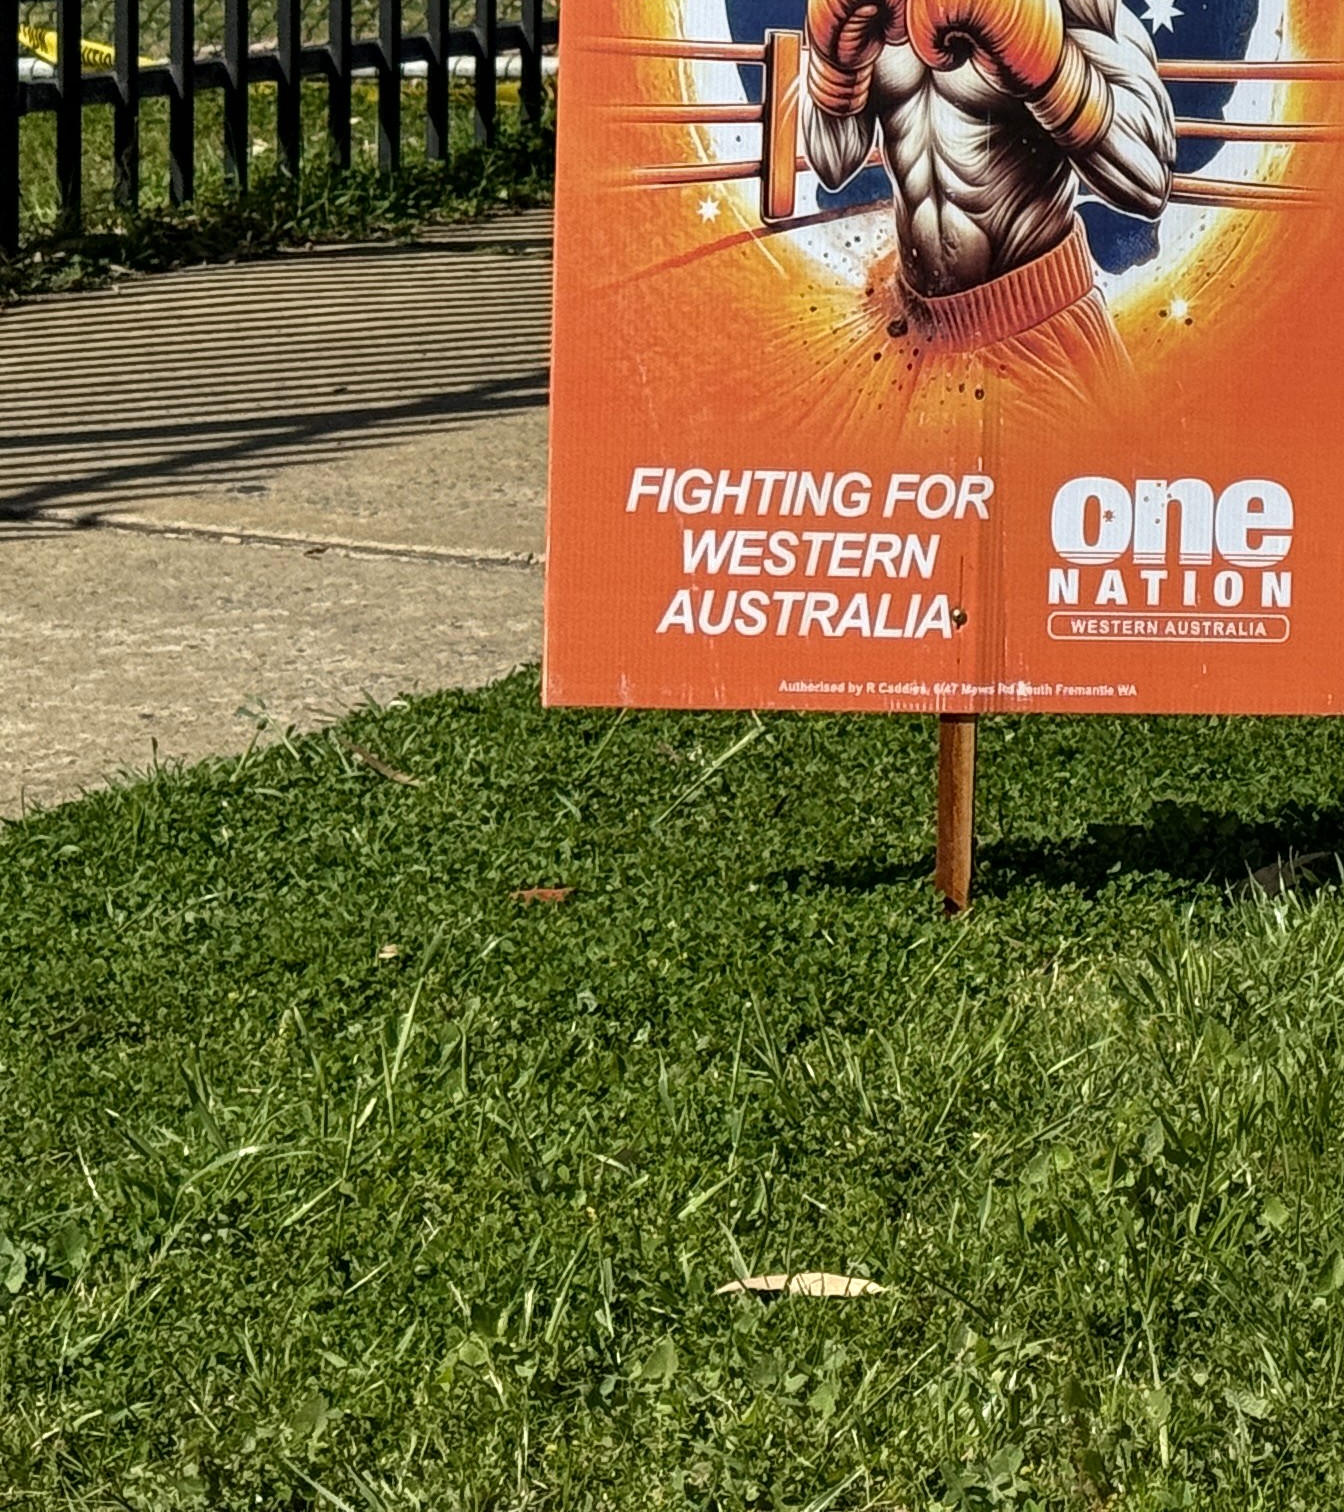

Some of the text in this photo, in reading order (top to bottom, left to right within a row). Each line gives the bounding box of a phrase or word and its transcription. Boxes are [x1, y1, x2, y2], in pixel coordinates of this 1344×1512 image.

[625, 467, 995, 520] FIGHTING FOR
[1051, 476, 1294, 568] one
[682, 528, 940, 580] WESTERN
[1047, 567, 1292, 608] NATION
[655, 589, 953, 640] AUSTRALIA
[1070, 618, 1267, 638] WESTERN AUSTRALIA
[778, 680, 845, 694] Authorised
[848, 682, 863, 697] by
[867, 683, 875, 694] R
[1117, 684, 1137, 697] WA
